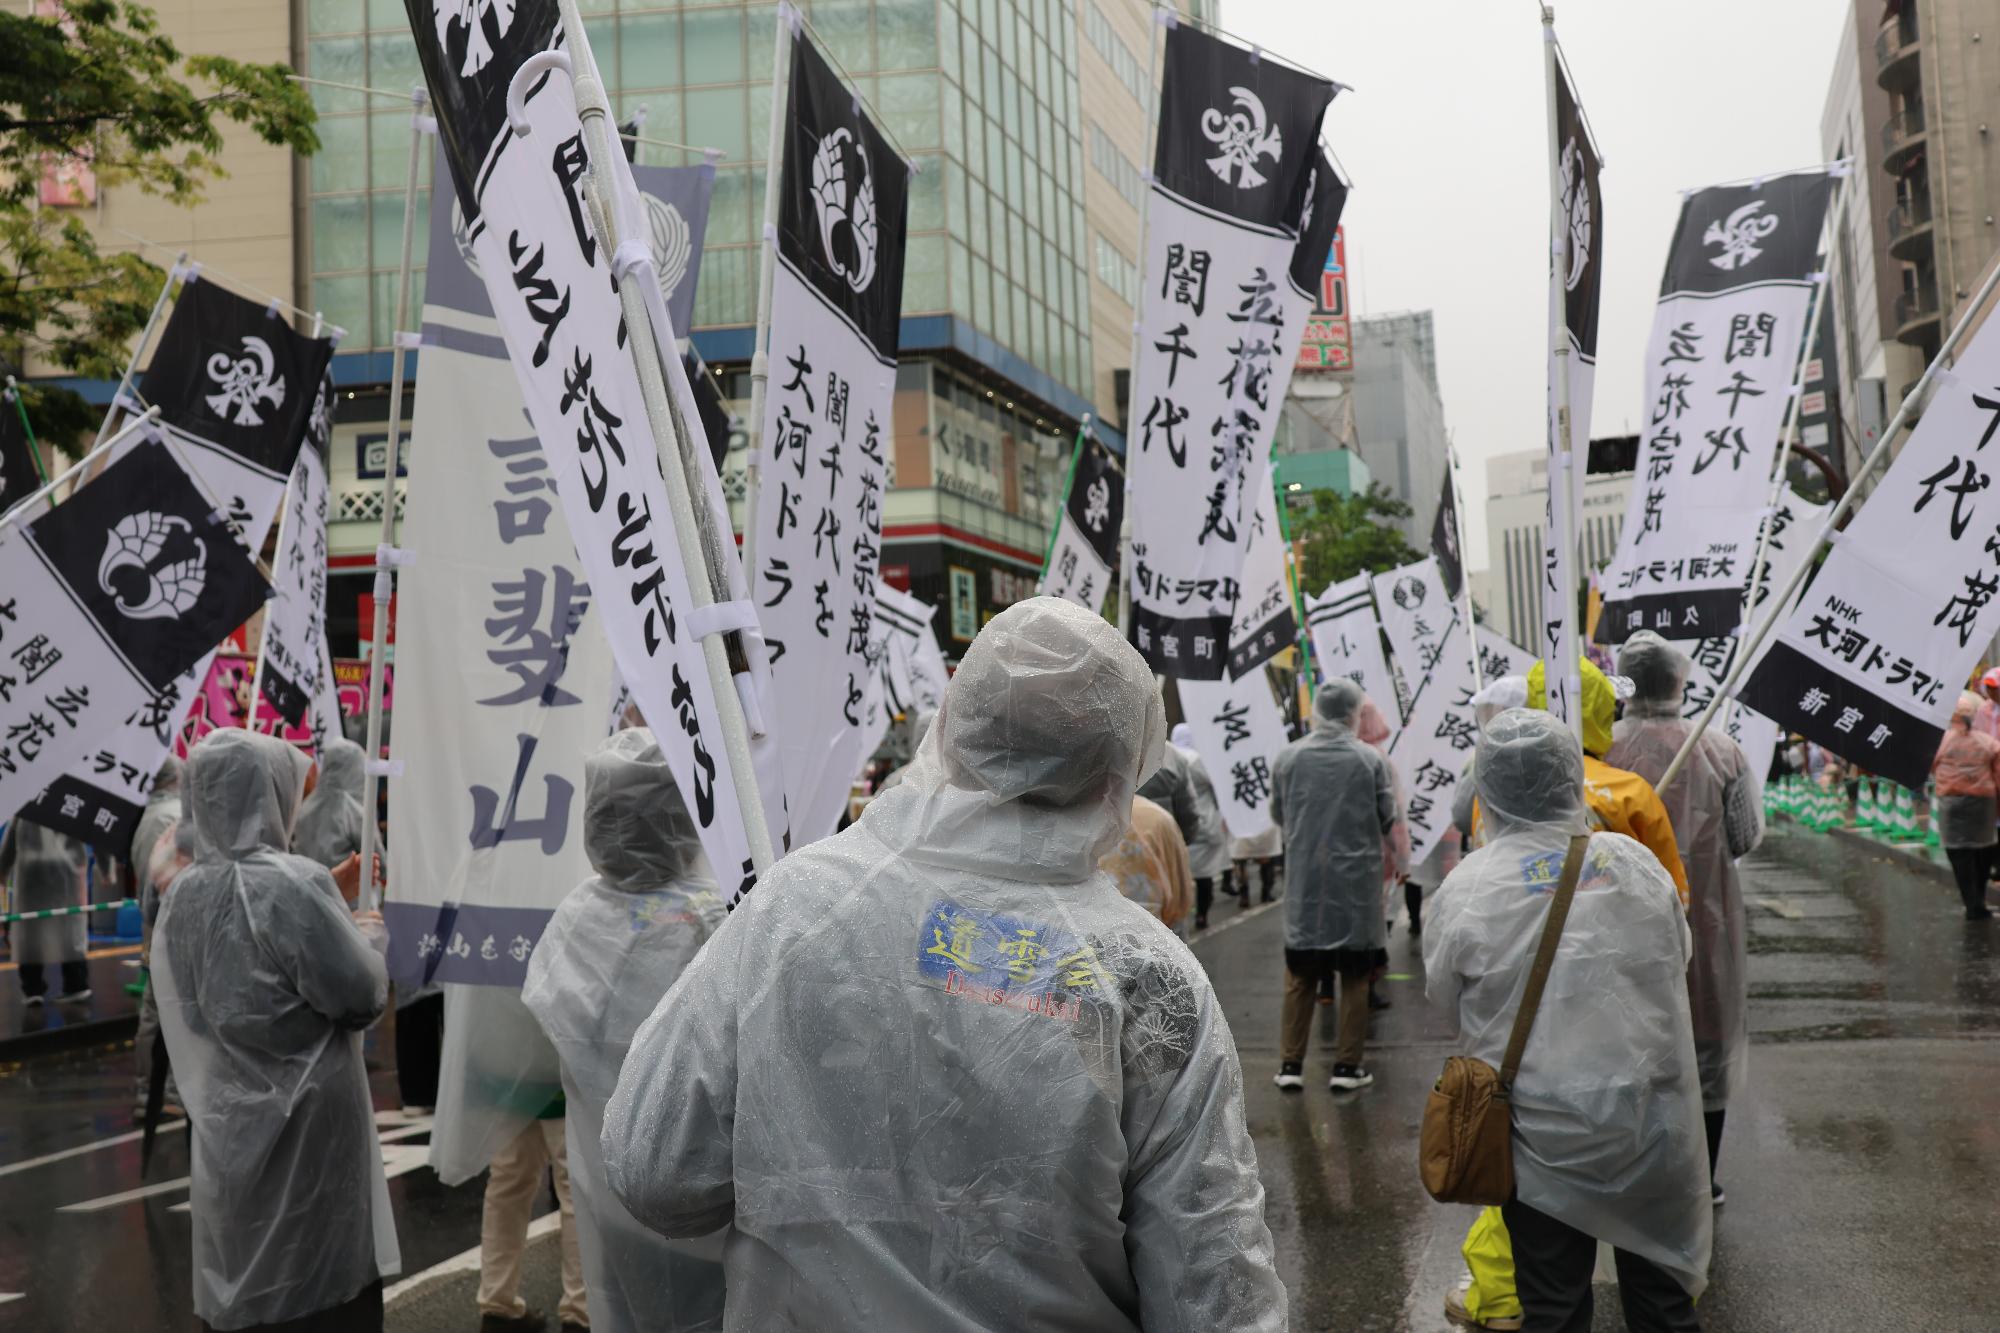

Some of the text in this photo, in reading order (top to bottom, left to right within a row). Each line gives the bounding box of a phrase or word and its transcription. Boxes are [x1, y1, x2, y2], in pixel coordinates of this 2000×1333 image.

[1142, 243, 1211, 468] 誾千代
[811, 371, 850, 638] 誾千代を
[844, 410, 884, 727] 立花宗茂と
[1824, 595, 1863, 624] NHK
[1136, 624, 1216, 661] 新宮町
[1804, 614, 1945, 707] 大河ドラマに
[1798, 687, 1893, 750] 新宮町
